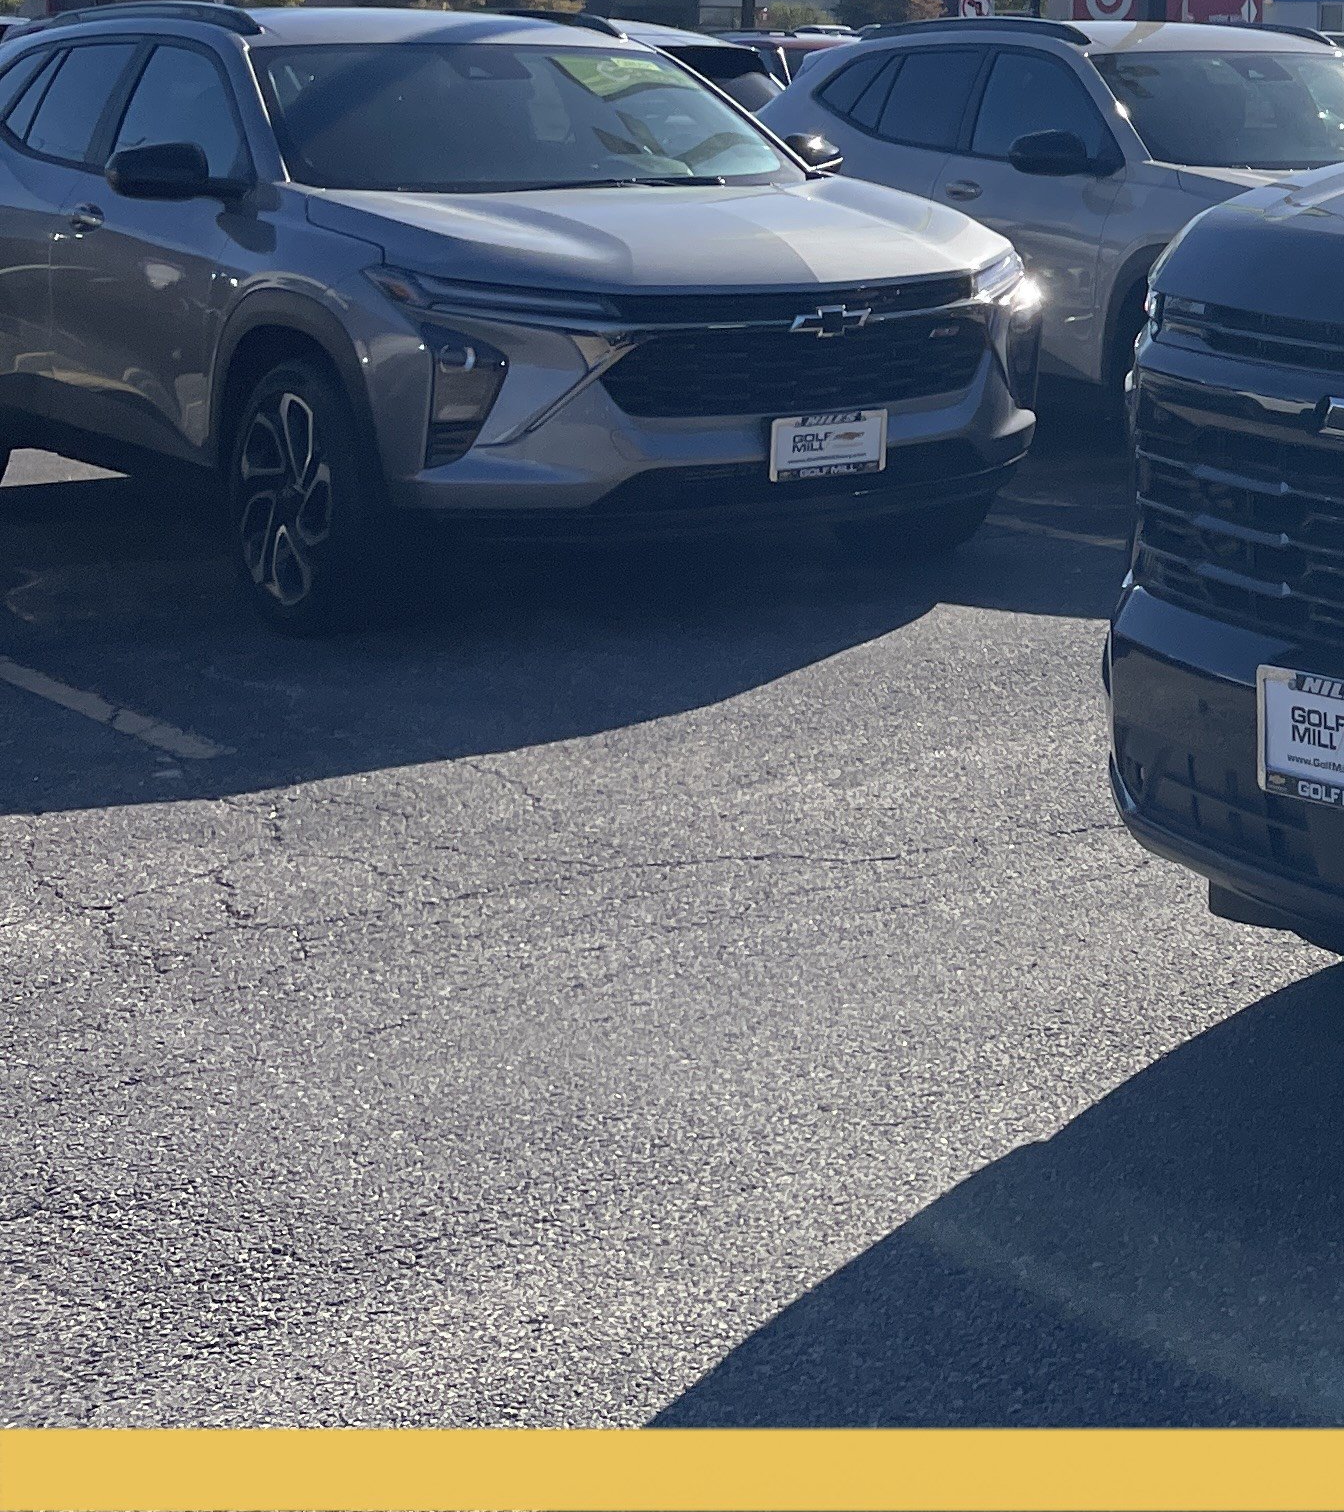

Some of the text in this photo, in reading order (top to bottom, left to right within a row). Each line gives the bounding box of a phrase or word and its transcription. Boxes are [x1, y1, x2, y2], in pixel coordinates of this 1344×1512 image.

[792, 431, 833, 443] GOLF
[791, 441, 824, 453] MILL
[1291, 724, 1337, 750] MILL
[1298, 780, 1340, 803] GOLF
